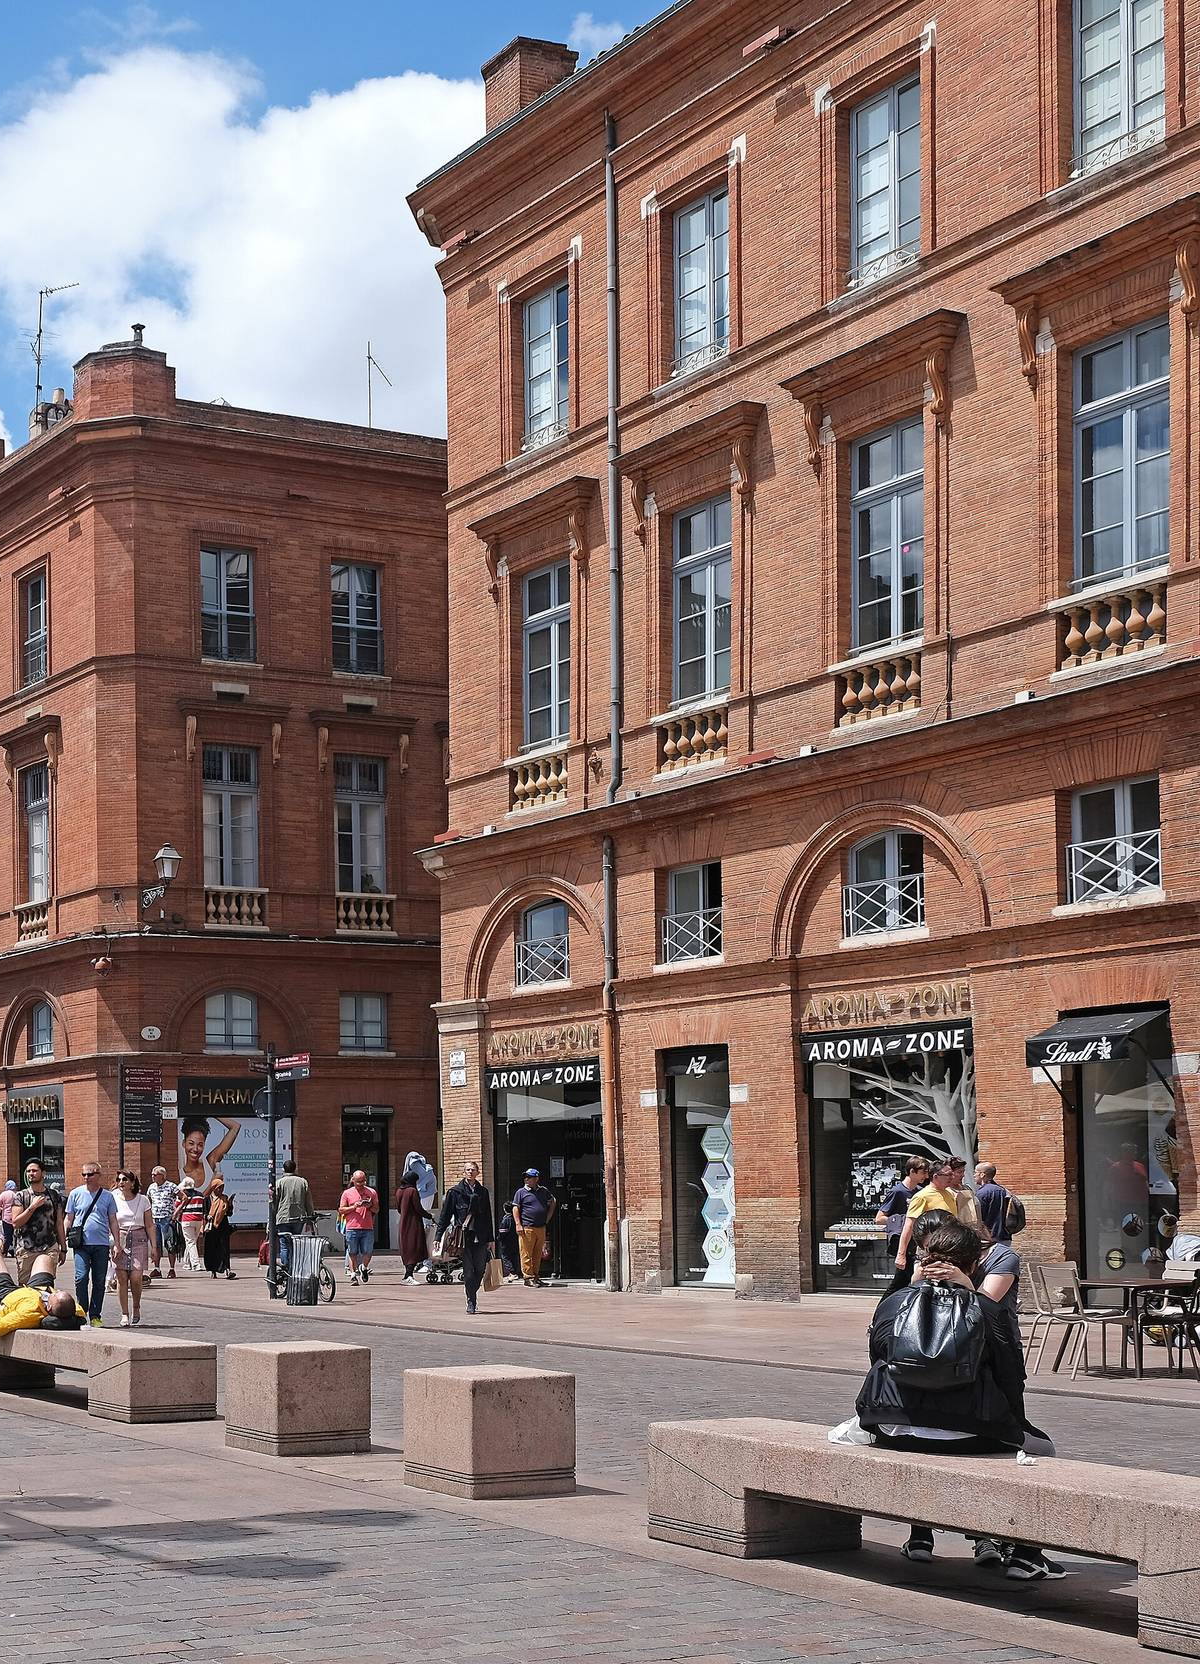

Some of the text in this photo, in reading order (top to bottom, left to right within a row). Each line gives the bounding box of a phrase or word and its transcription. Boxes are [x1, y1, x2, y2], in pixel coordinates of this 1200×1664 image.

[803, 982, 969, 1018] AROMA ZONE
[808, 1029, 965, 1061] AROMA ZONE
[1040, 1041, 1098, 1064] Lindt
[490, 1065, 595, 1089] AROMA ZONE
[188, 1088, 253, 1105] PHARM
[243, 1128, 284, 1139] ROSE
